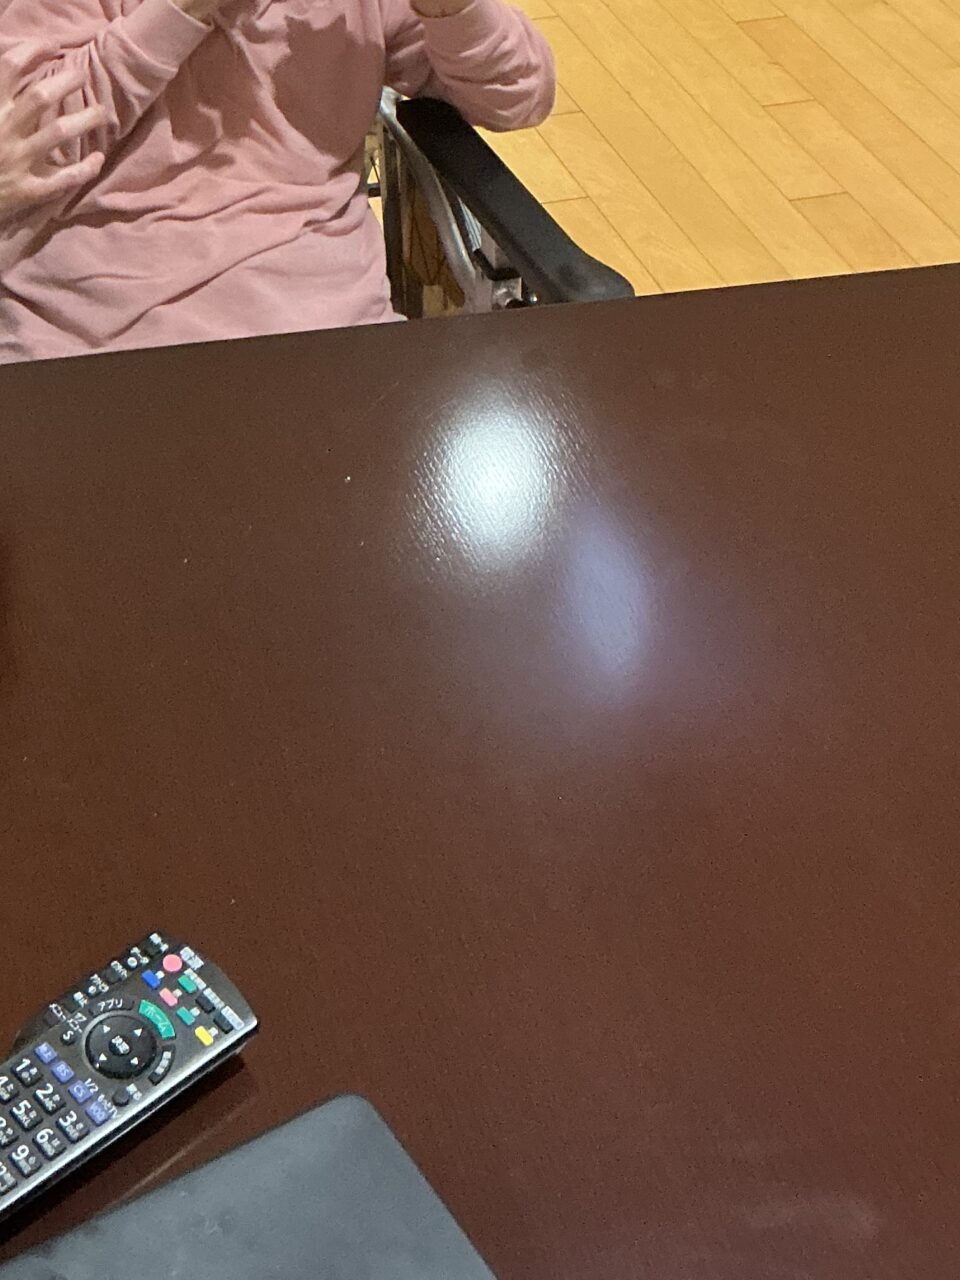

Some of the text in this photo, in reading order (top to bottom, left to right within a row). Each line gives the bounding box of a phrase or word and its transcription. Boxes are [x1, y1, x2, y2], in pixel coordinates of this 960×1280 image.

[98, 999, 123, 1011] アプリ
[144, 1004, 171, 1033] ホーム
[63, 1030, 74, 1040] S
[16, 1058, 31, 1071] 1
[56, 1064, 69, 1076] BS
[36, 1083, 53, 1100] 2
[73, 1084, 86, 1097] CS
[84, 1078, 99, 1094] 1/2
[13, 1100, 31, 1117] 5
[59, 1111, 77, 1127] 3
[36, 1128, 53, 1145] 6
[12, 1145, 29, 1163] 9
